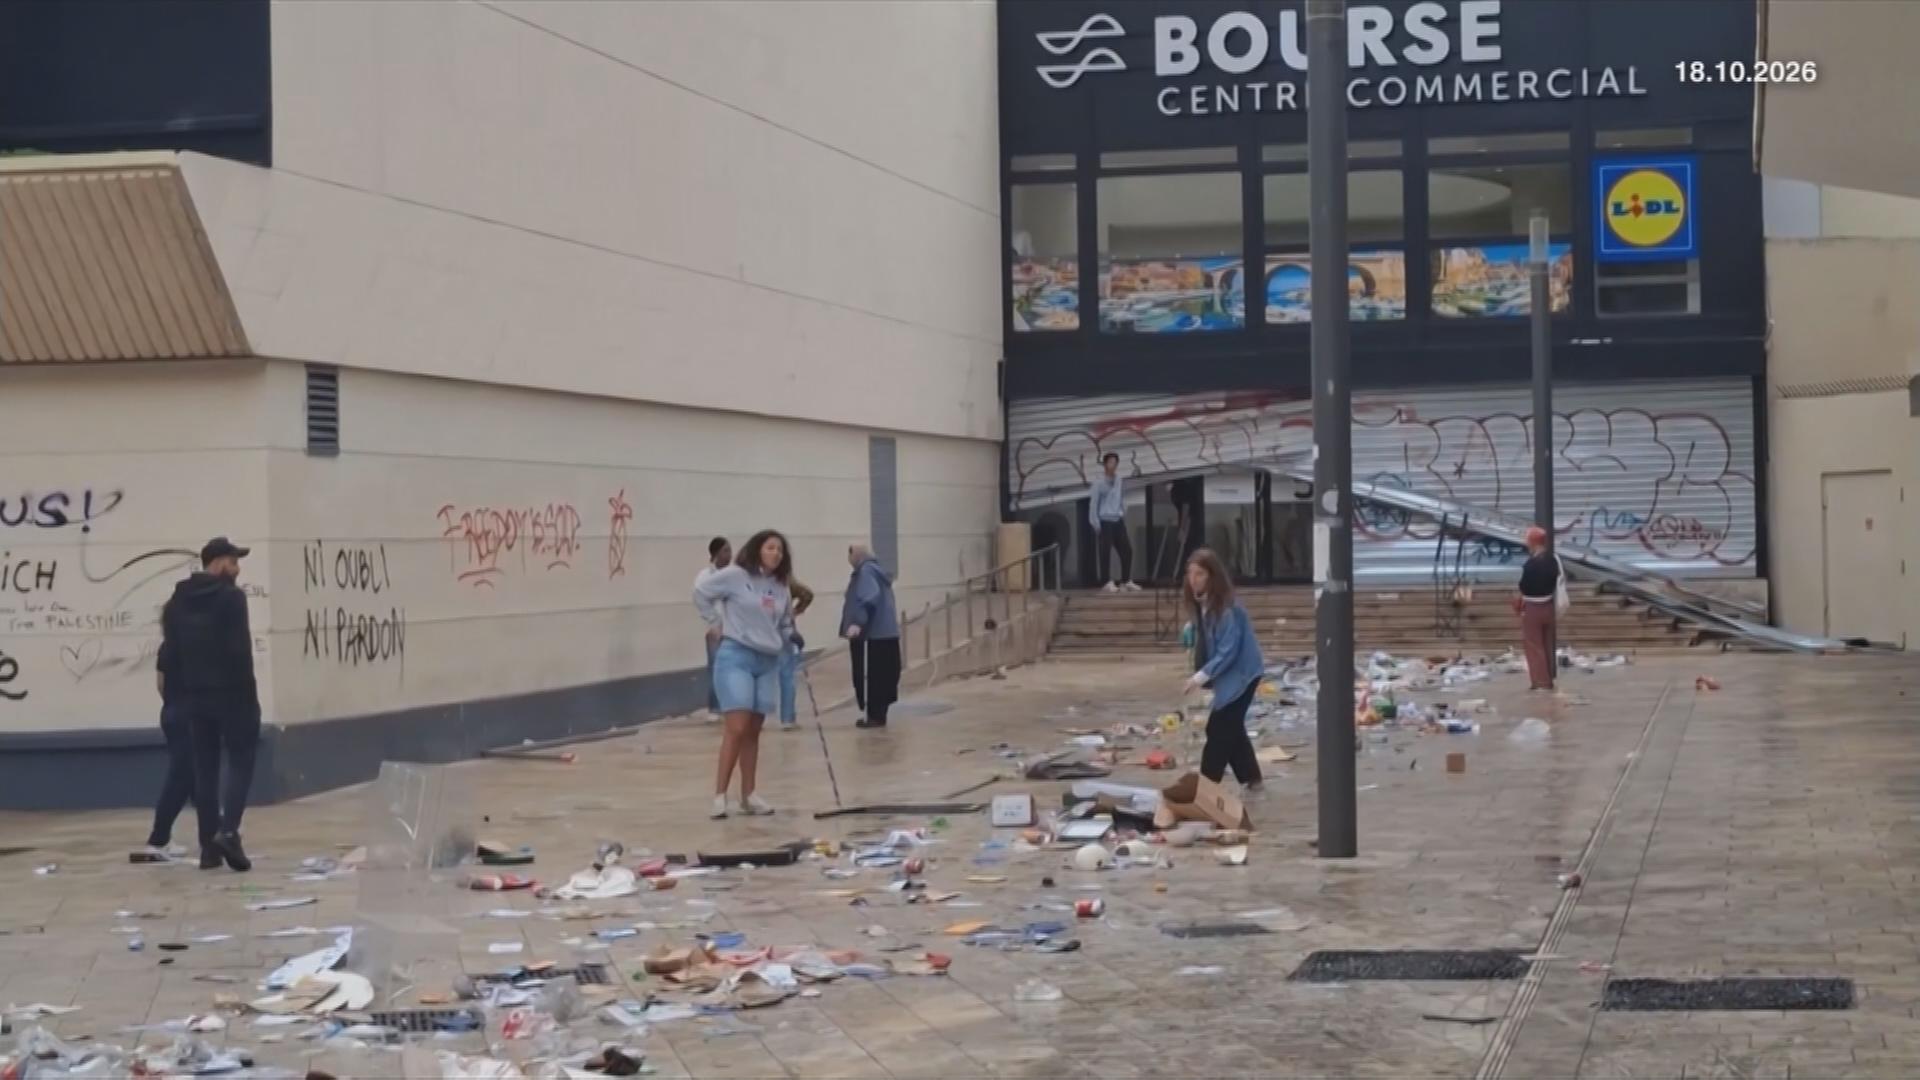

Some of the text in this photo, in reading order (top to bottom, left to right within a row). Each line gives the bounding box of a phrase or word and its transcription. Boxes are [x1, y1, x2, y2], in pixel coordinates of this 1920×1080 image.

[1157, 65, 1648, 116] CENTR COMMERCIAL
[335, 543, 391, 594] OUBLI
[336, 606, 406, 668] PARDON
